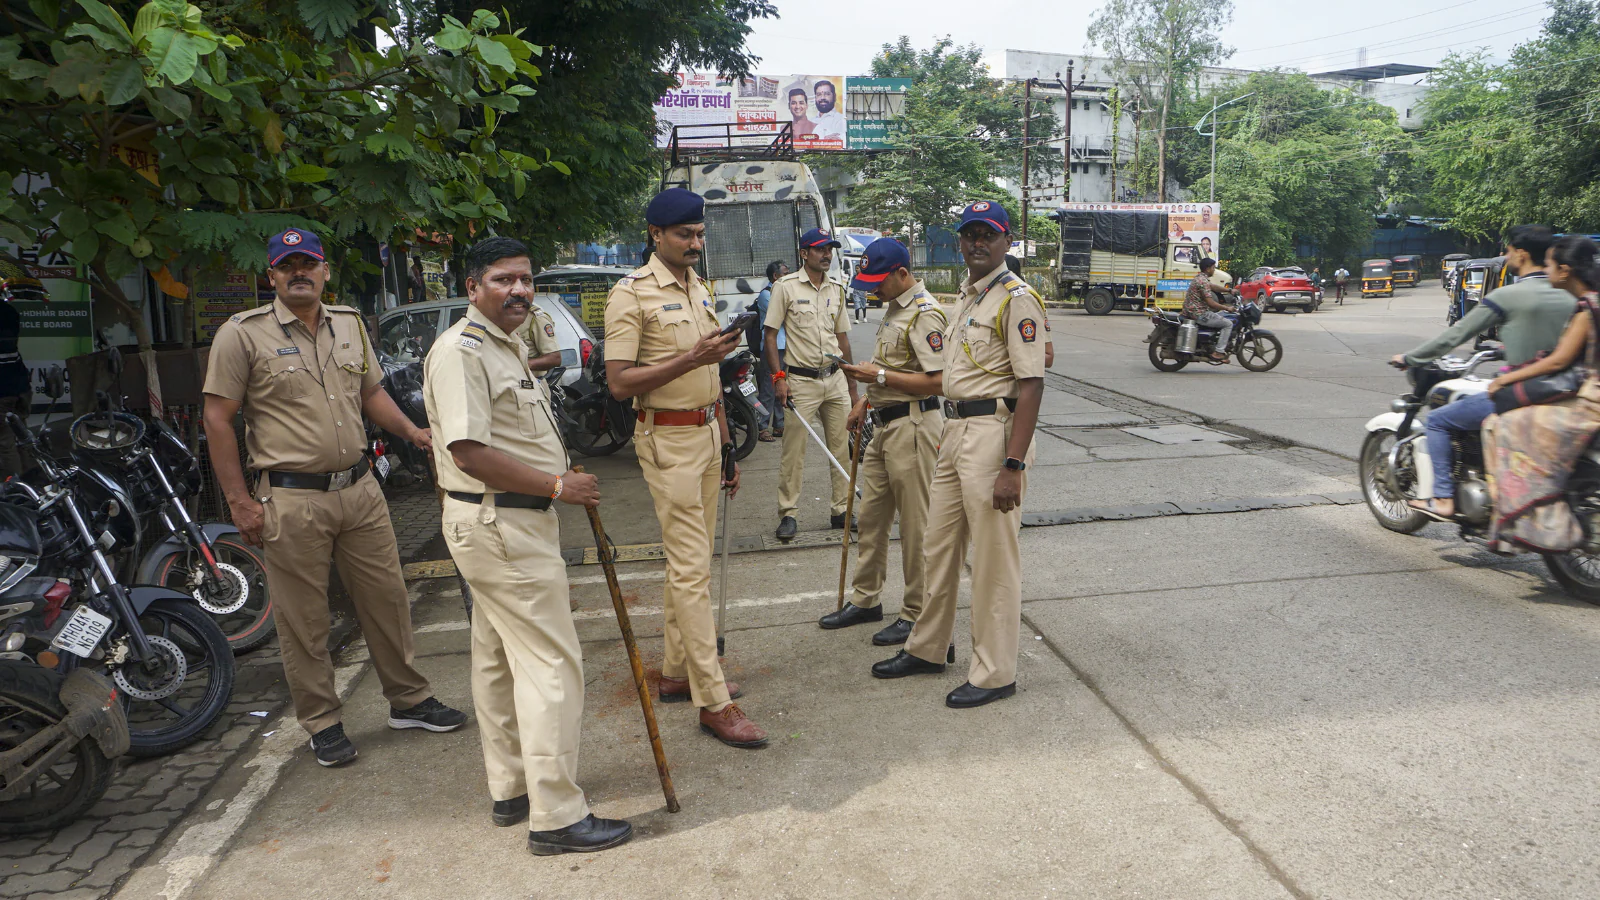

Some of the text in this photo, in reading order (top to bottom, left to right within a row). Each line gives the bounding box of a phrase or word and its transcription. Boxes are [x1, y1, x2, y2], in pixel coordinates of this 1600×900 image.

[701, 91, 732, 108] स्पर्धा
[738, 108, 775, 120] लोकार्पण
[726, 181, 763, 192] पोलीस
[59, 612, 91, 643] MH04K
[76, 620, 106, 650] N6109
